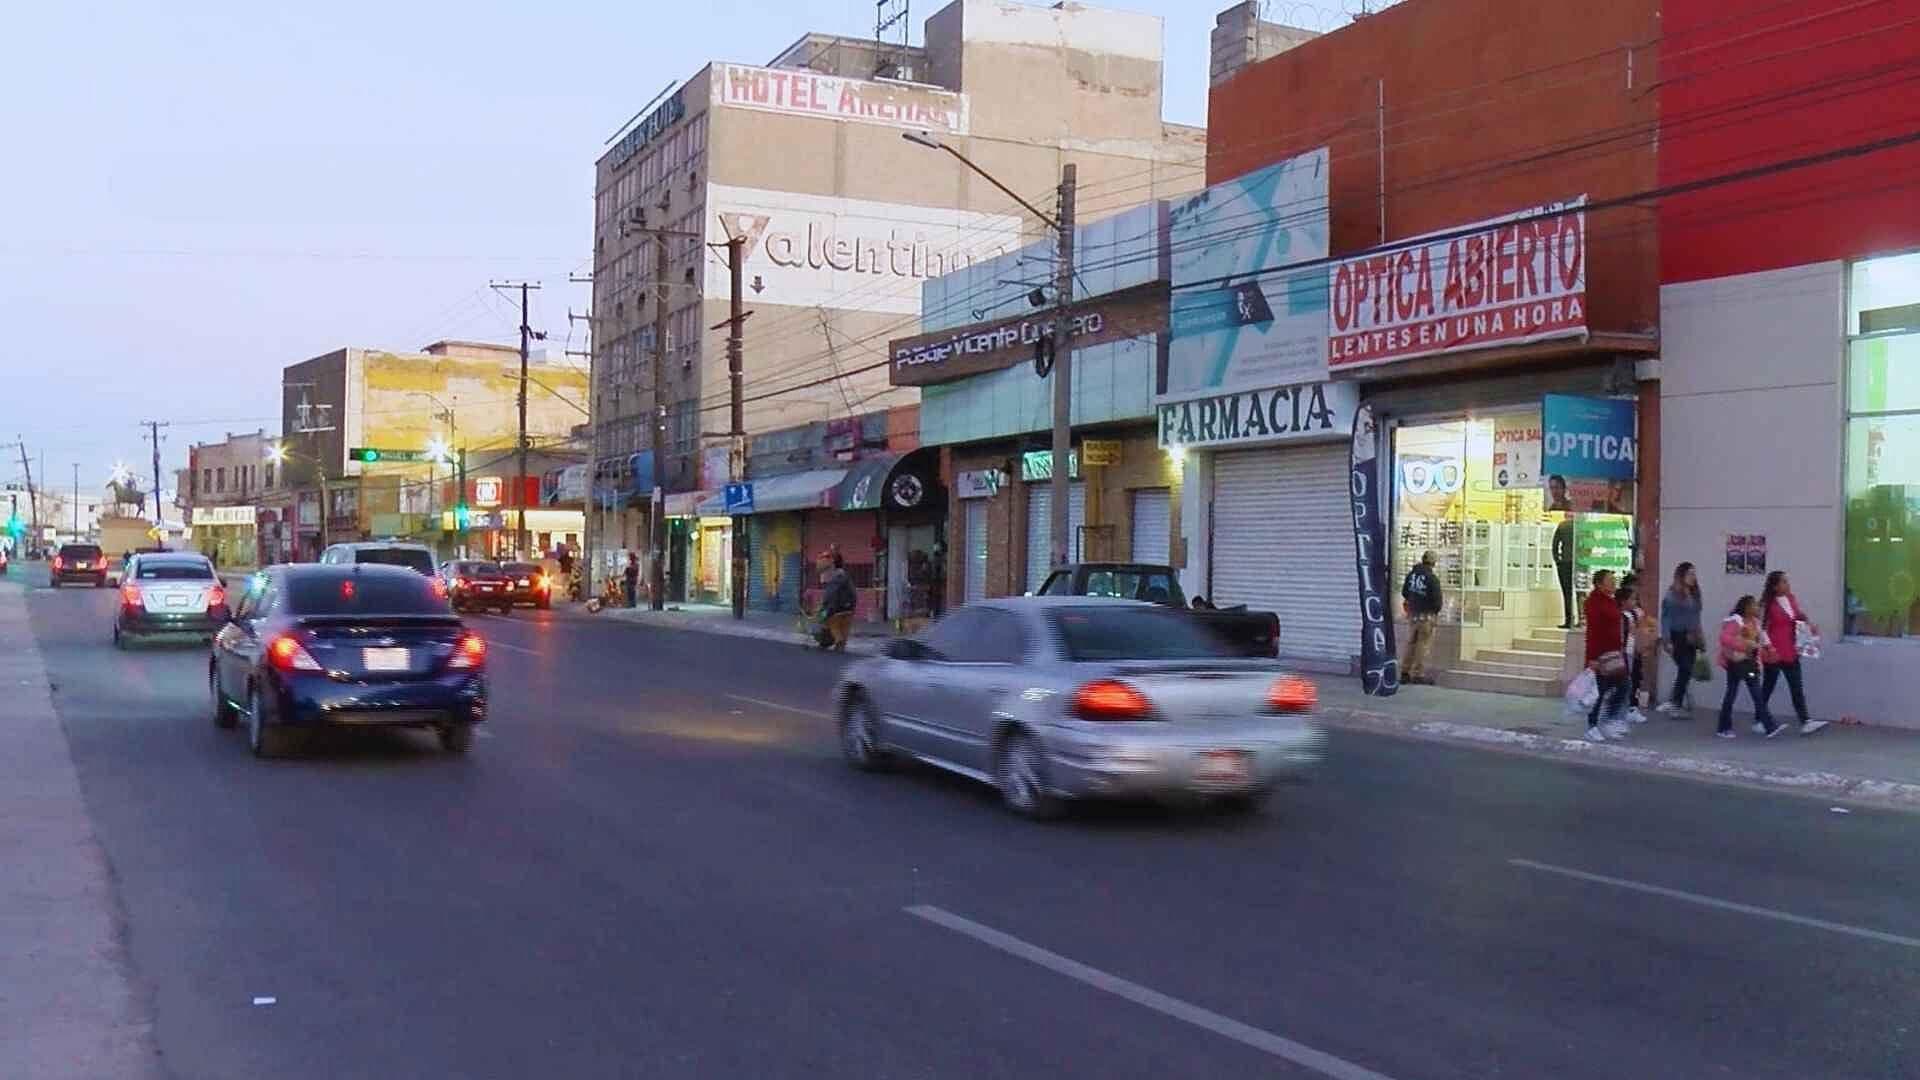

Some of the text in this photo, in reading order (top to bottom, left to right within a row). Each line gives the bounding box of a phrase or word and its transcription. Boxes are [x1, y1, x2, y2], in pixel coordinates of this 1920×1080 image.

[729, 67, 827, 111] HOTEL
[1333, 213, 1582, 332] OPTICA ABIERTO
[952, 326, 1018, 357] Vicente
[1332, 329, 1411, 359] LENTES
[1420, 323, 1447, 345] EN
[1457, 313, 1504, 338] UNA
[1513, 298, 1583, 329] HORA
[1161, 383, 1336, 446] FARMACIA
[1543, 424, 1635, 462] ÓPTICA
